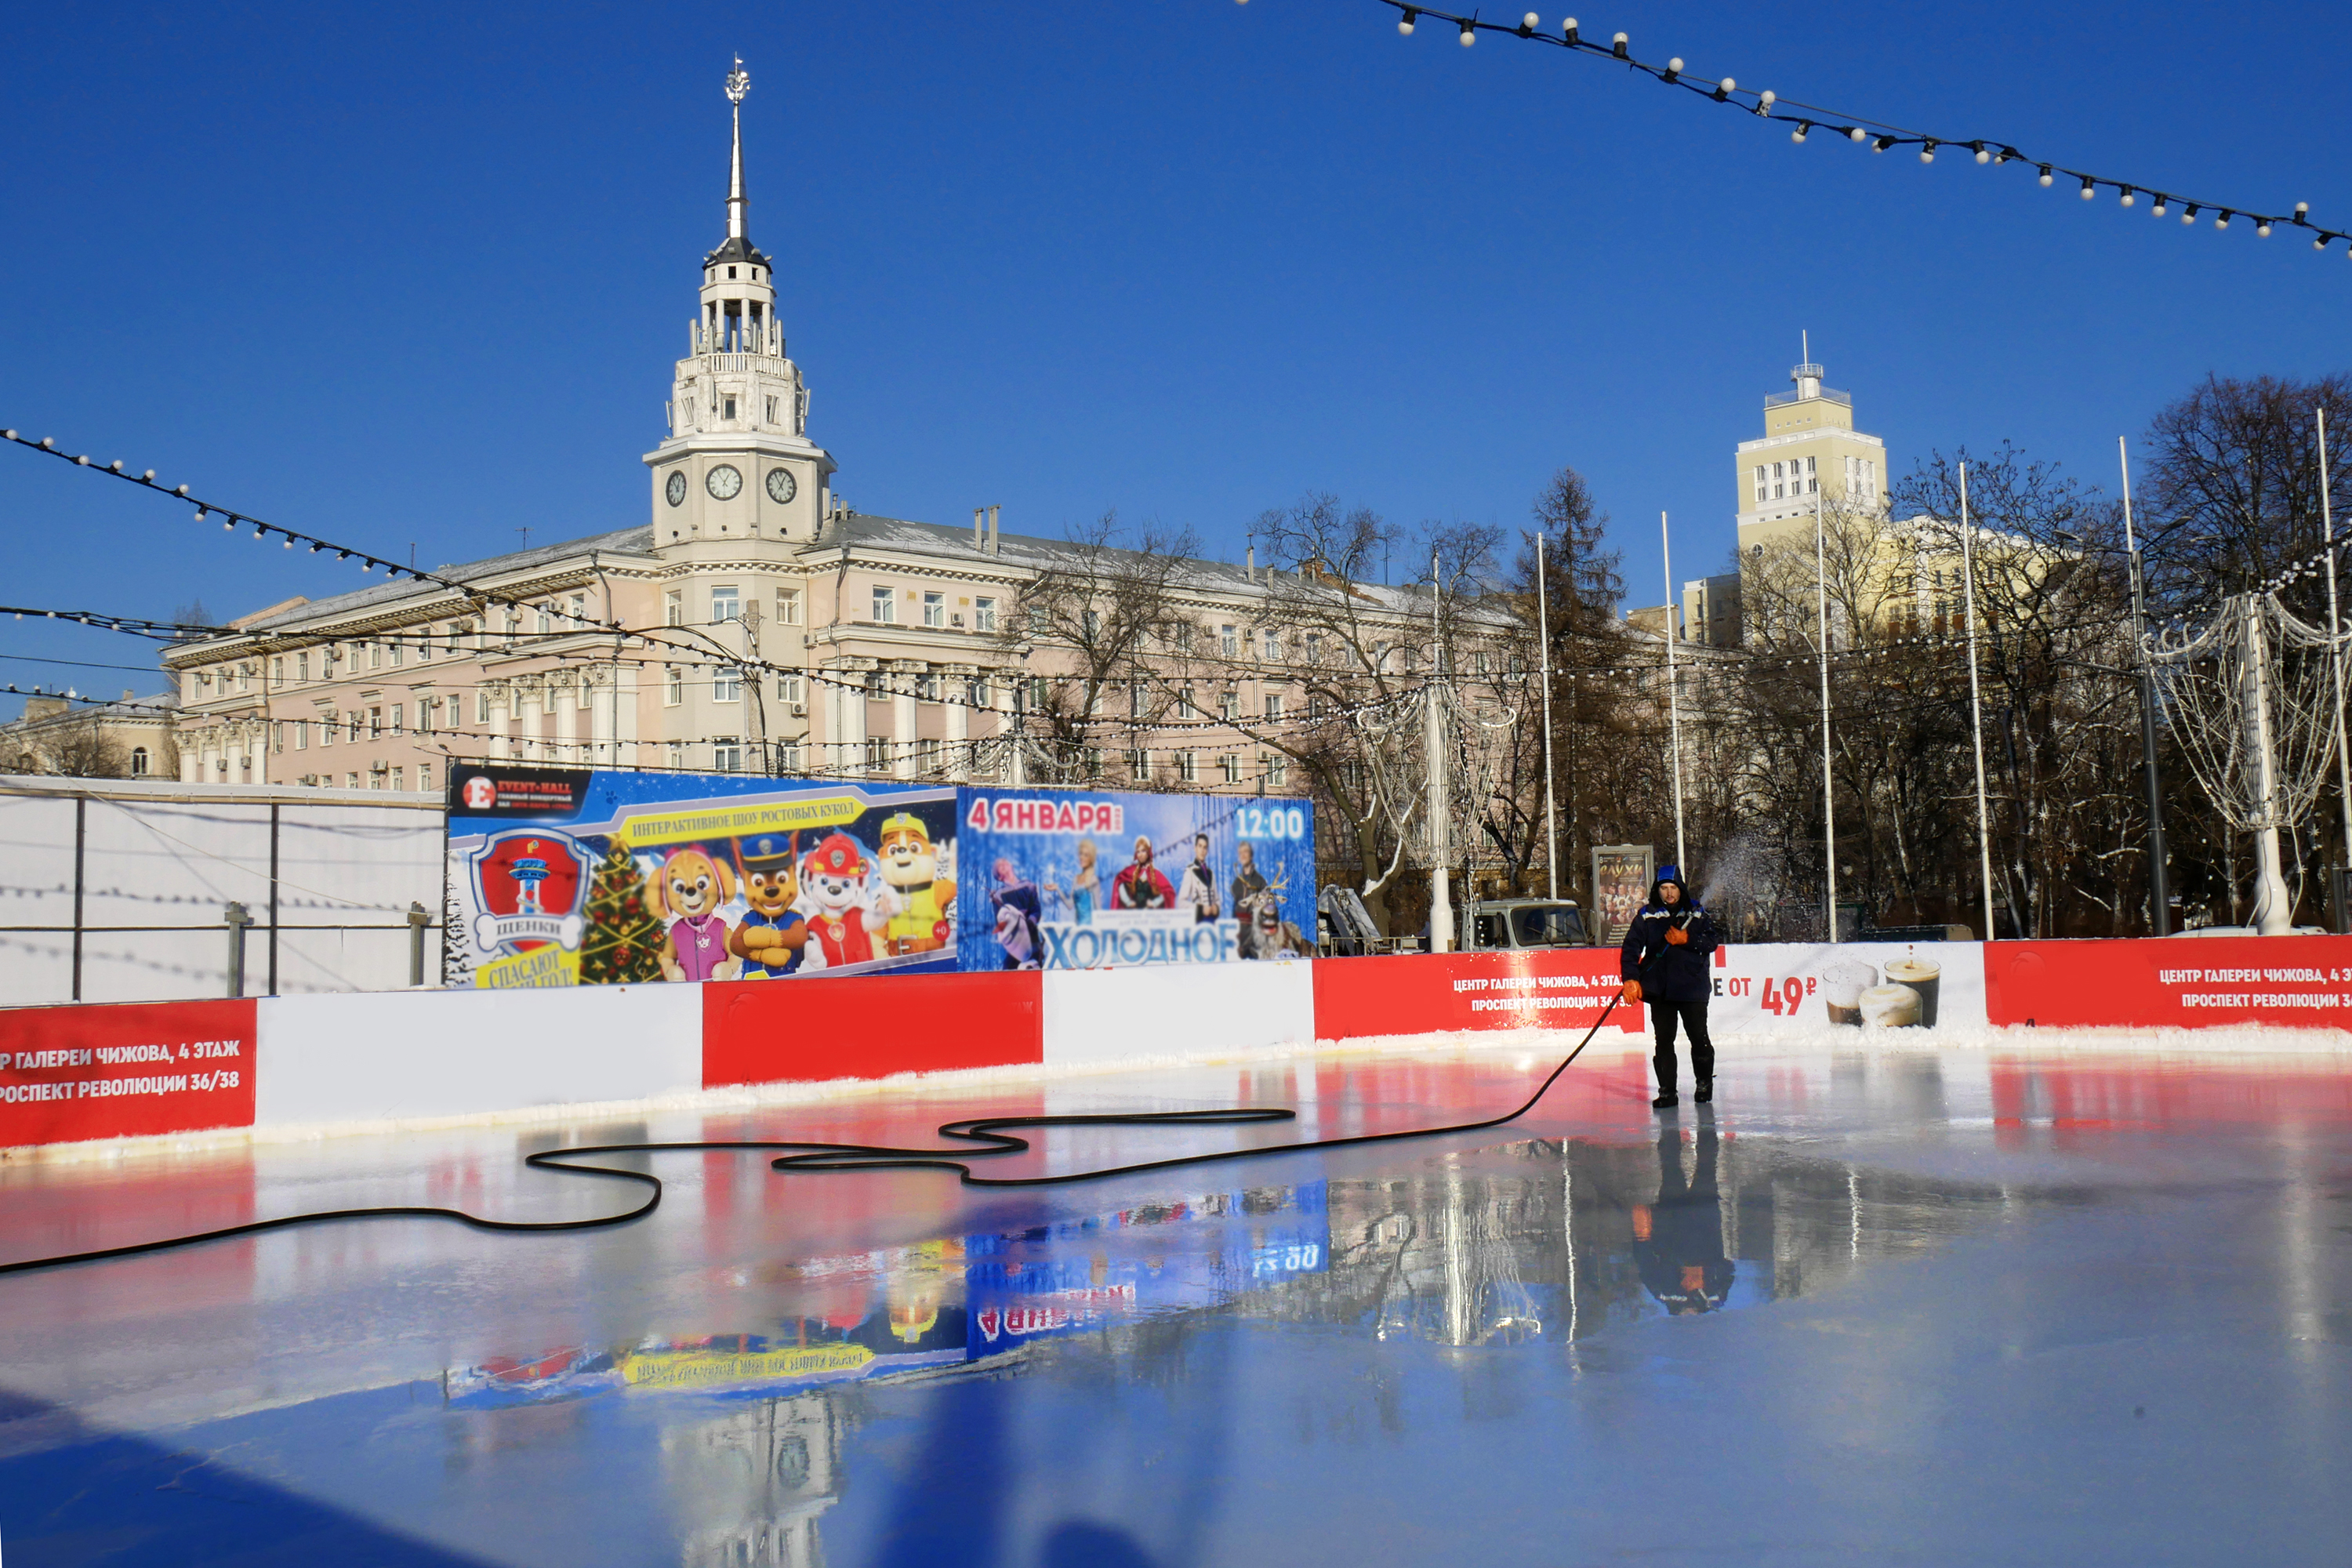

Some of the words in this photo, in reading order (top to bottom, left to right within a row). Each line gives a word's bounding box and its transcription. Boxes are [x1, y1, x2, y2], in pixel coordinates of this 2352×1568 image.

[633, 815, 731, 837] ИНТЕРАКТИВНОЕ
[732, 811, 759, 827] ШОУ
[760, 805, 818, 823] РОСТОВЫХ
[820, 801, 855, 818] КУКОЛ
[971, 801, 987, 829] 4
[996, 802, 1111, 832] ЯНВАРЯ
[1236, 808, 1302, 839] 12:00
[497, 920, 561, 936] ЩЕНКИ
[489, 949, 561, 989] СПАСАЮТ
[2159, 969, 2201, 985] ЦЕНТР
[2205, 969, 2261, 982] ГАЛЕРЕИ
[2263, 968, 2328, 985] ЧИЖОВА,
[2330, 968, 2339, 982] 4
[2342, 967, 2352, 982] Э
[1454, 979, 1488, 993] ЦЕНТР
[1490, 978, 1537, 990] ГАЛЕРЕИ
[1538, 975, 1589, 989] ЧИЖОВА,
[1591, 975, 1599, 986] 4
[1600, 975, 1624, 987] ЭТА
[1729, 977, 1751, 996] ОТ
[1472, 998, 1529, 1011] ПРОСПЕКТ
[1530, 996, 1599, 1010] РЕВОЛЮЦИИ
[2182, 994, 2250, 1007] ПРОСПЕКТ
[2252, 994, 2339, 1009] РЕВОЛЮЦИИ
[16, 1048, 92, 1069] ГАЛЕРЕИ
[96, 1044, 175, 1064] ЧИЖОВА,
[178, 1043, 190, 1059] 4
[193, 1040, 241, 1058] ЭТАЖ
[78, 1074, 187, 1098] РЕВОЛЮЦИИ
[191, 1069, 240, 1092] 36/38
